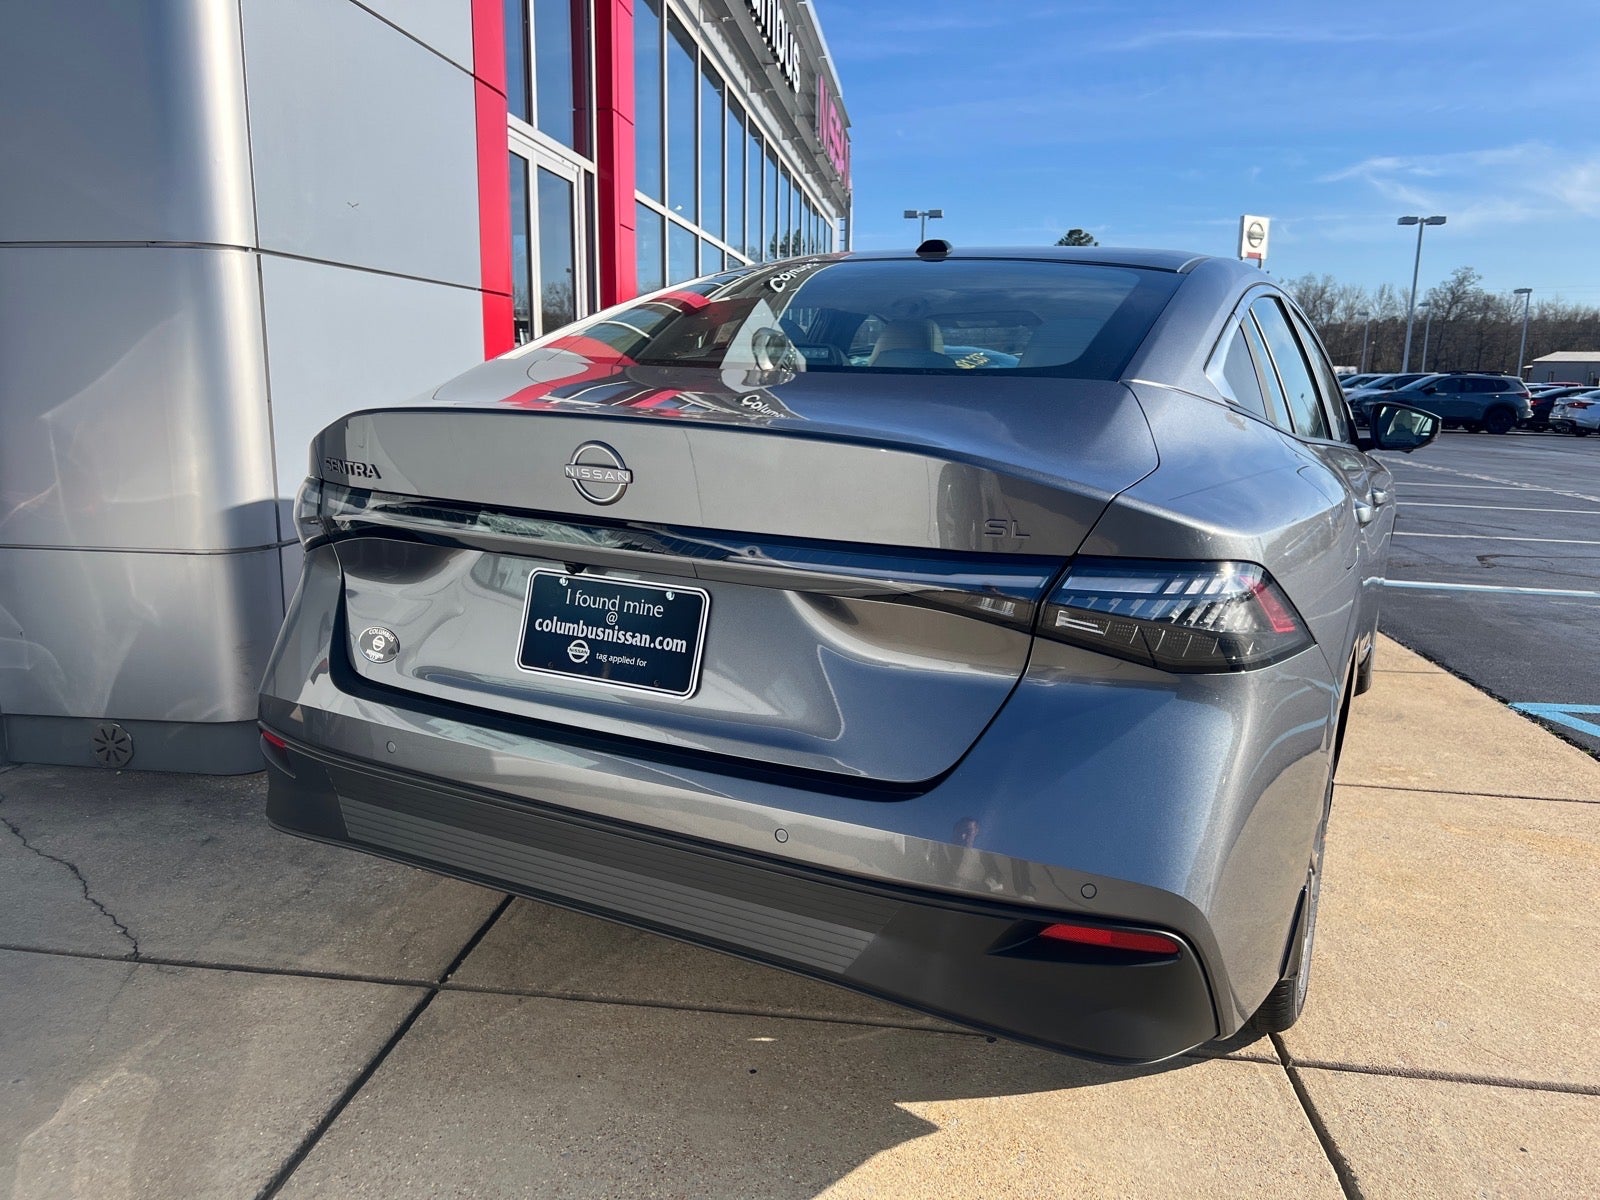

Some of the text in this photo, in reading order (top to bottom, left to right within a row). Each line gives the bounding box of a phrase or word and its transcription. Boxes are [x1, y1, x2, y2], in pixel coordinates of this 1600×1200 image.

[751, 0, 800, 94] mbus
[325, 457, 382, 480] SENTRA
[564, 466, 630, 482] NISSAN
[984, 518, 1031, 539] SL
[566, 589, 664, 618] I found mine
[606, 612, 618, 625] @
[534, 616, 687, 654] columbusnissan.com
[568, 647, 589, 656] NISSAN
[595, 652, 648, 667] tag applied for
